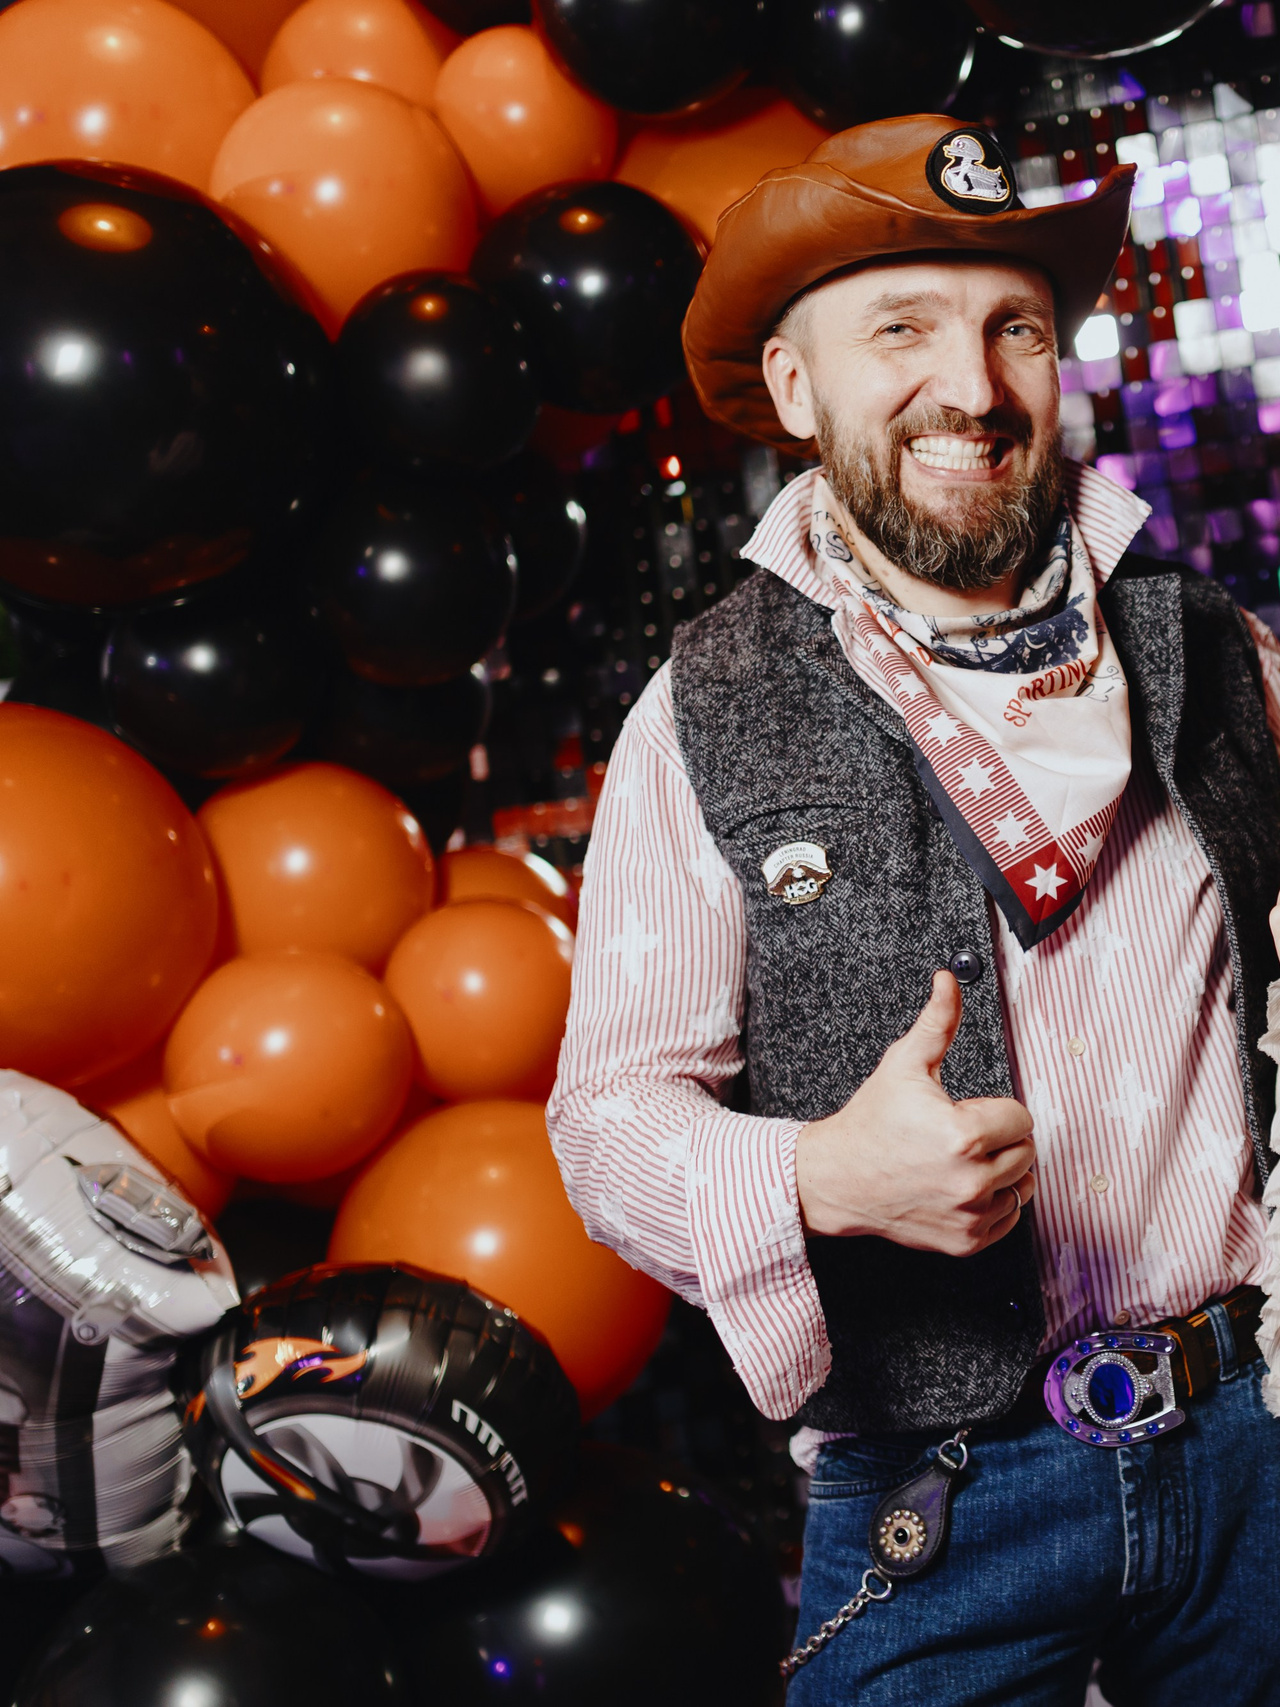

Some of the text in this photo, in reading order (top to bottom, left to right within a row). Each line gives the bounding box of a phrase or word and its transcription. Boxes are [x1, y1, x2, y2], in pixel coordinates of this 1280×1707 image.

[1003, 658, 1090, 727] SPORTIN
[779, 847, 806, 857] LENINGRAD
[773, 855, 794, 869] CHAPTER
[784, 878, 818, 898] HOG
